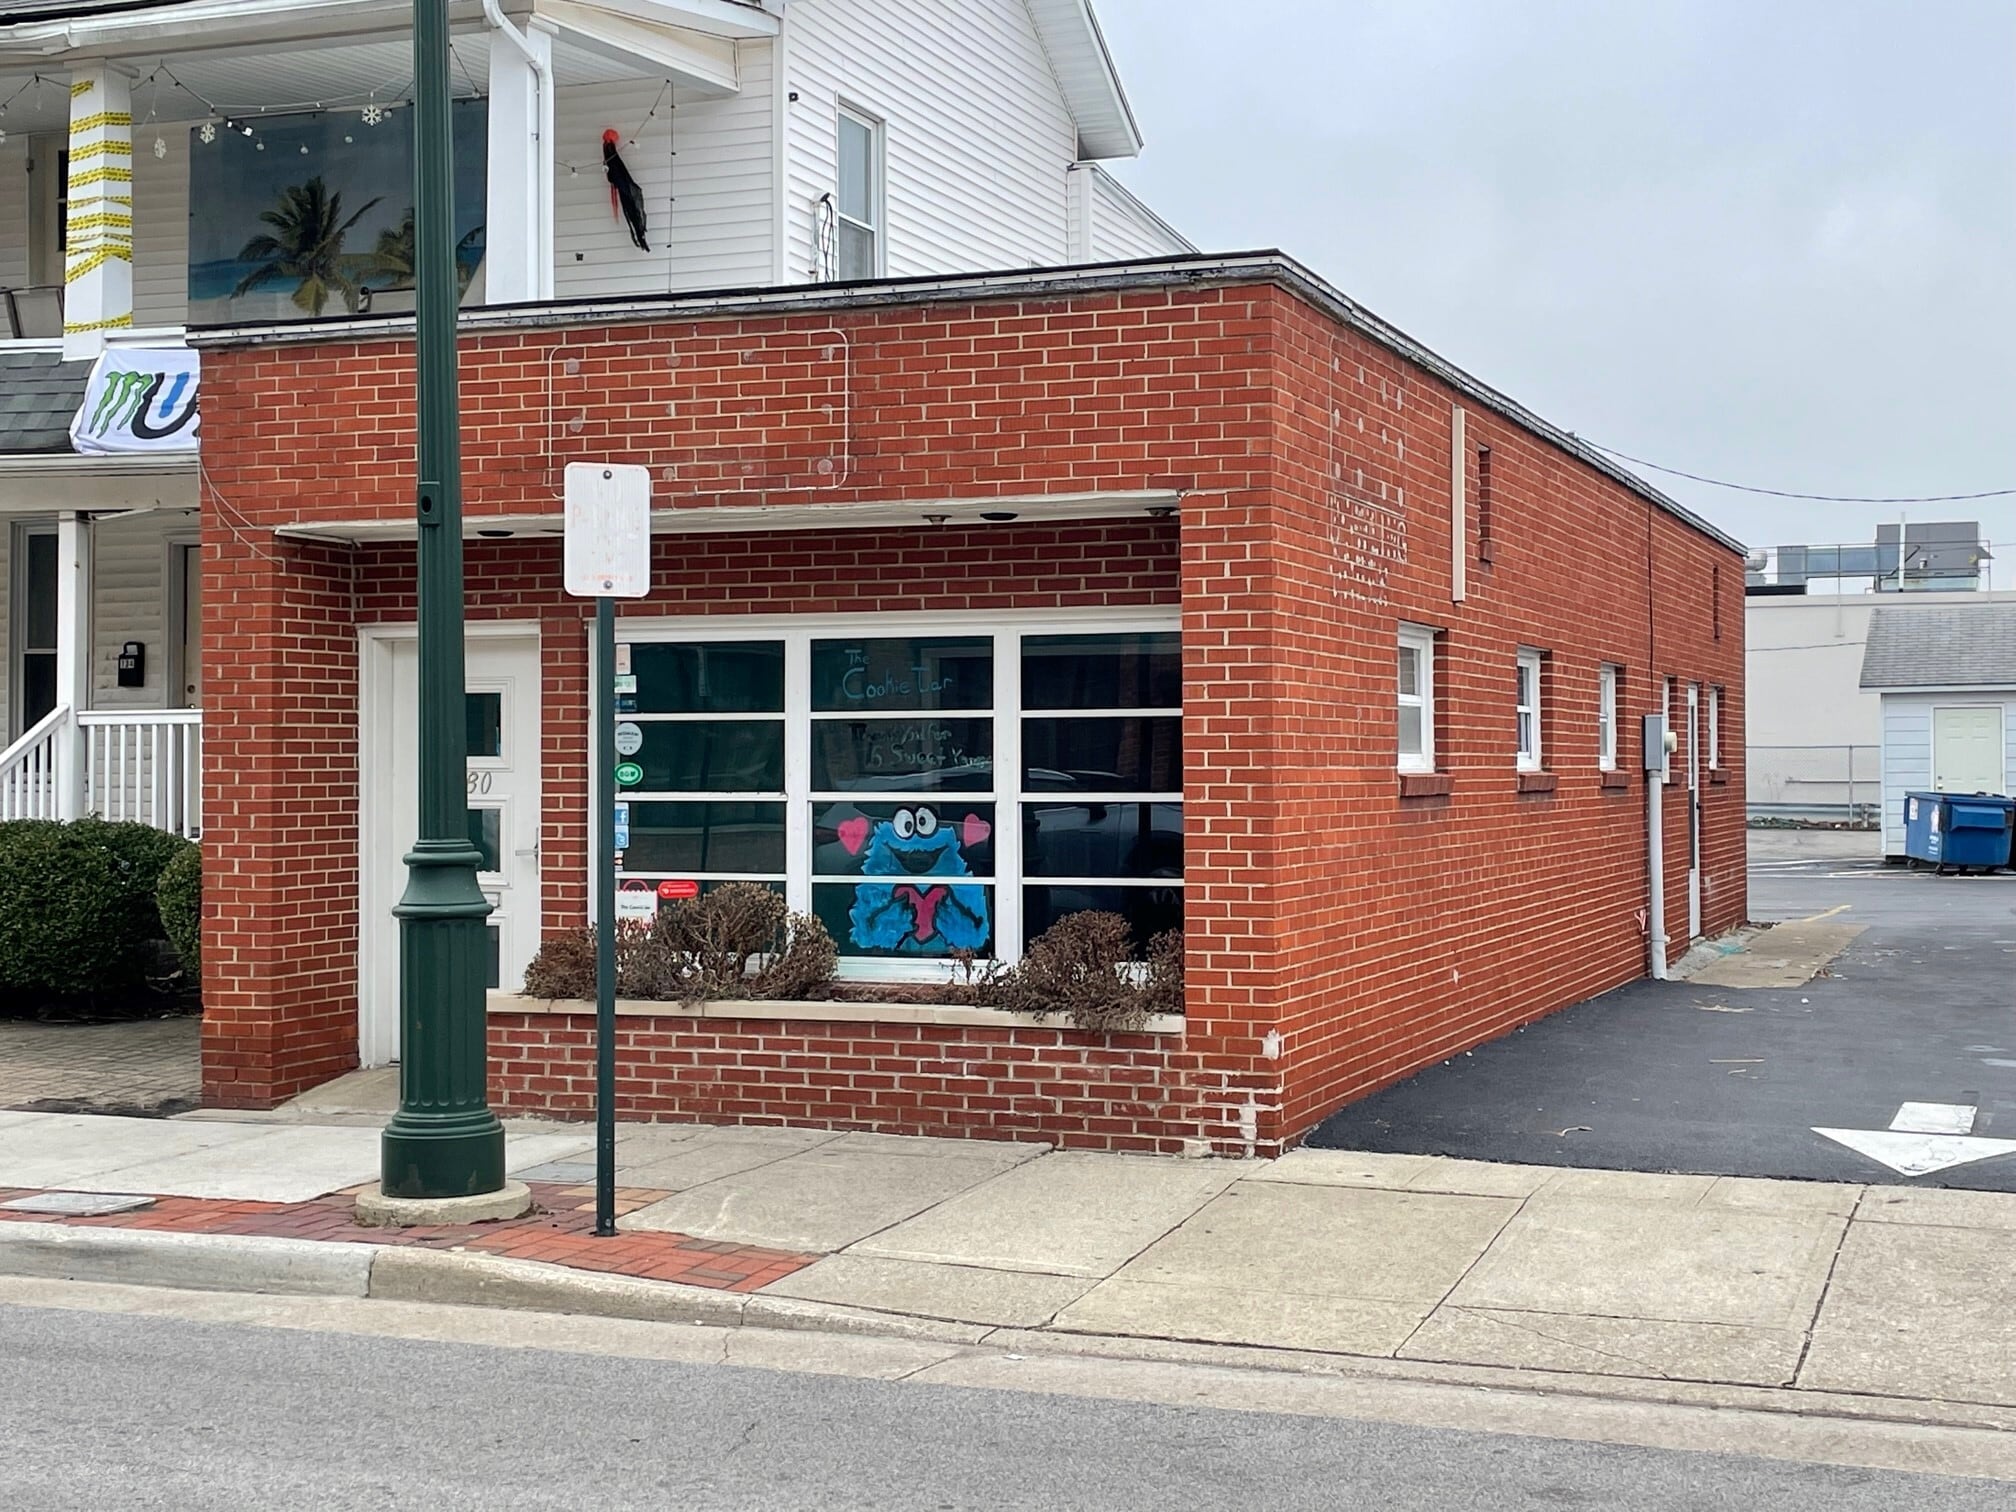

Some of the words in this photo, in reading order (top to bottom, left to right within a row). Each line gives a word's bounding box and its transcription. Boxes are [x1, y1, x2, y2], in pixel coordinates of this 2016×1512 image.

[843, 648, 871, 665] The
[842, 667, 911, 699] Cookie
[911, 667, 953, 693] Jar
